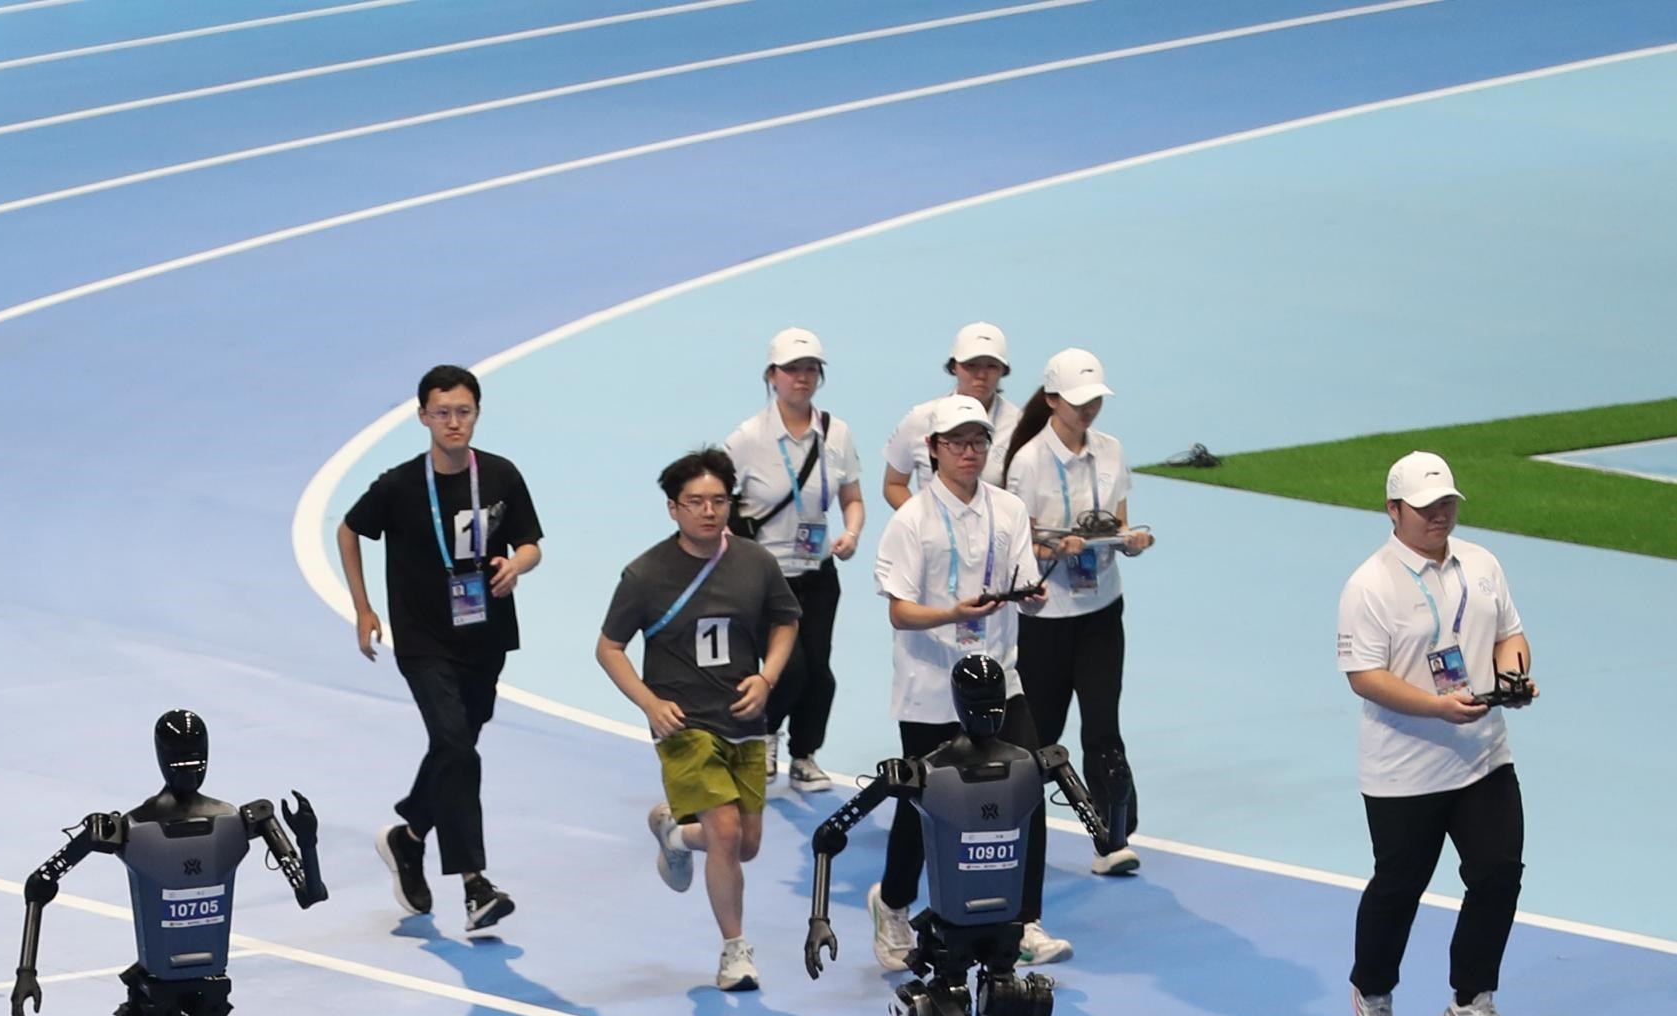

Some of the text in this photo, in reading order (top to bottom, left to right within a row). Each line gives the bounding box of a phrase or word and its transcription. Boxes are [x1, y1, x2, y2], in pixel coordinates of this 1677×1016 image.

[702, 623, 718, 660] 1
[967, 844, 1014, 860] 109 01
[169, 899, 219, 918] 107 05
